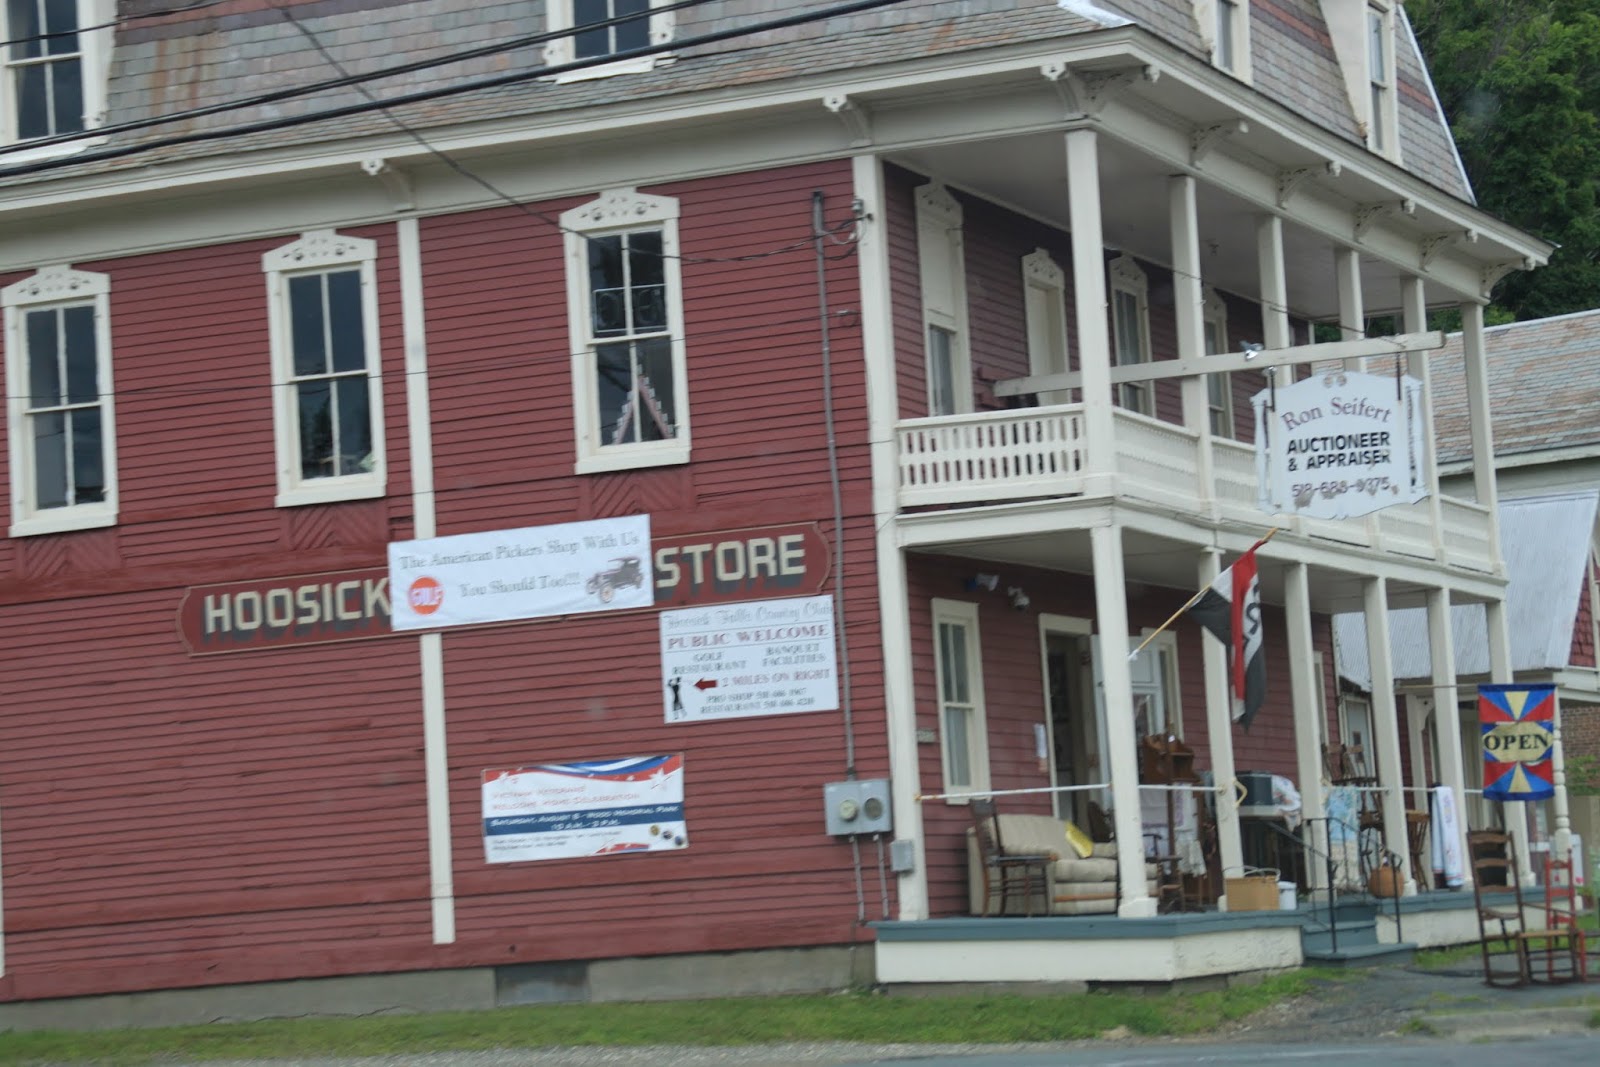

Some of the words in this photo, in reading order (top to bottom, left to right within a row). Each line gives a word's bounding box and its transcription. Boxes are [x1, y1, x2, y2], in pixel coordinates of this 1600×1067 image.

[1281, 407, 1323, 431] Ron
[1331, 397, 1391, 422] Seifert
[1287, 432, 1390, 455] AUCTIONEER
[1288, 459, 1298, 471] &
[1307, 450, 1391, 469] APPRAISER
[400, 555, 427, 570] The
[430, 549, 493, 566] American
[496, 543, 543, 560] Pickers
[546, 537, 580, 555] Shop
[584, 534, 618, 549] With
[620, 531, 640, 547] Us
[204, 577, 392, 634] HOOSICK
[655, 534, 807, 588] STORE
[459, 582, 486, 597] You
[488, 578, 535, 594] Should
[667, 633, 731, 650] PUBLIC
[736, 624, 829, 643] WELCOME
[693, 651, 724, 663] GOLF
[1484, 734, 1548, 751] OPEN
